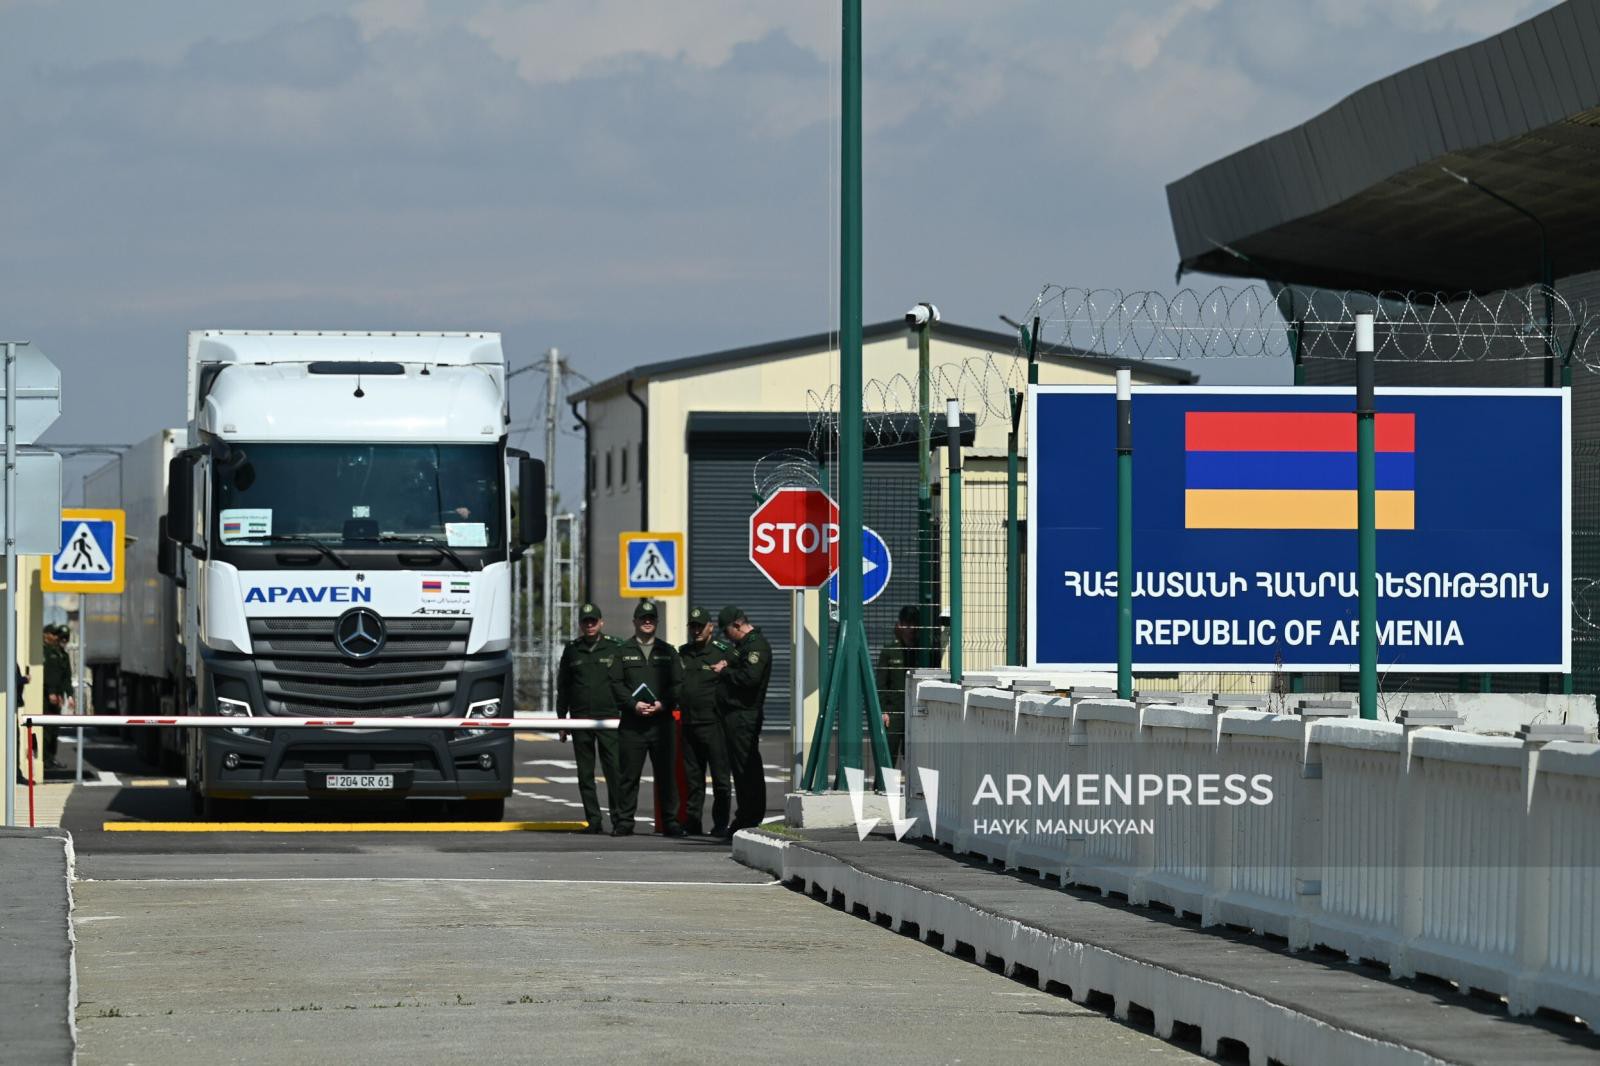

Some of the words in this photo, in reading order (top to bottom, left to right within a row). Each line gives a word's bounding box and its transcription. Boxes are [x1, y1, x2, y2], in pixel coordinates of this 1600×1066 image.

[755, 522, 839, 554] STOP
[244, 586, 371, 603] APAVEN
[1135, 619, 1277, 645] REPUBLIC
[1284, 619, 1322, 646] OF
[340, 776, 357, 786] 204
[361, 776, 374, 786] CR
[378, 776, 389, 786] 61
